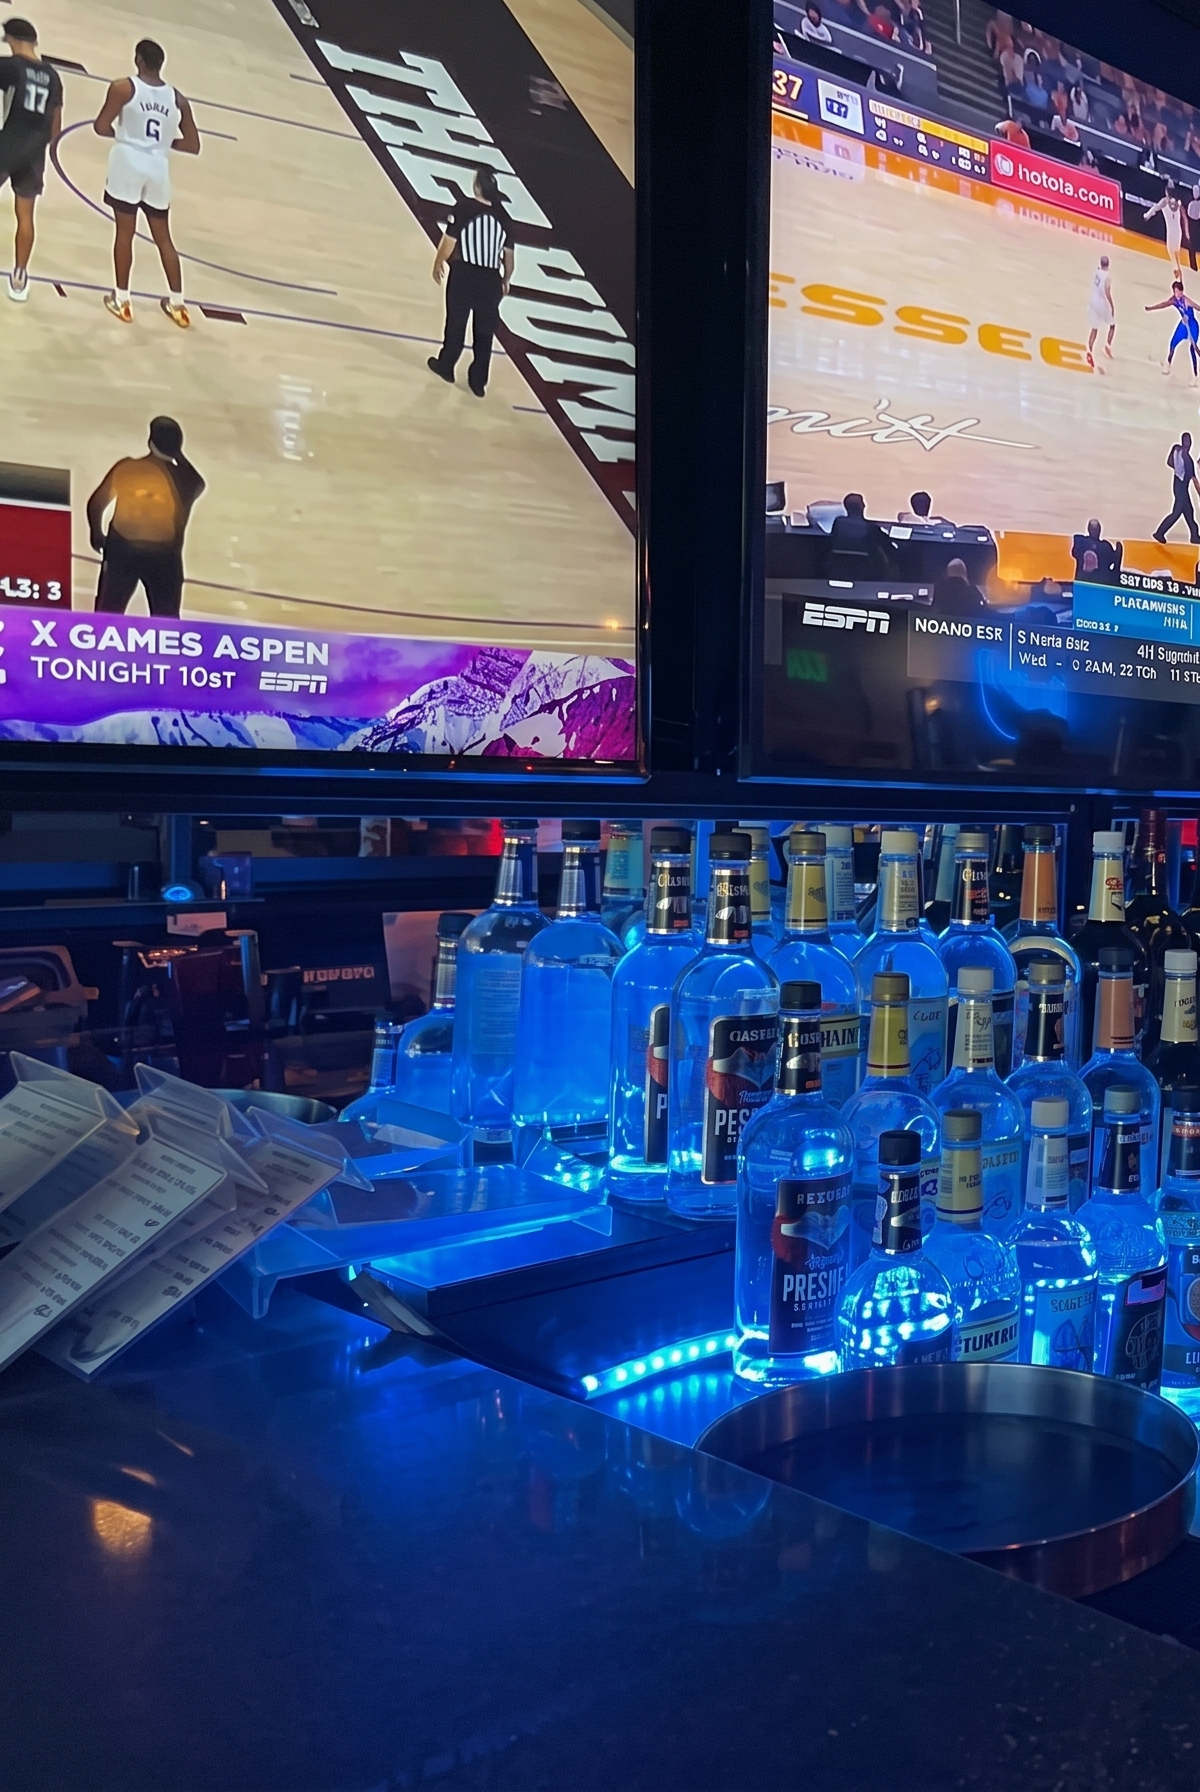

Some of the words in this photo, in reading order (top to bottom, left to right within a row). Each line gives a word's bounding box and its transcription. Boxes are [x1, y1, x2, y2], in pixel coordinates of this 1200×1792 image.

[315, 38, 552, 232] THE
[47, 581, 62, 601] 3
[802, 602, 890, 634] ESPN
[31, 620, 57, 647] X
[69, 625, 203, 657] GAMES
[213, 635, 329, 666] ASPEN
[30, 656, 170, 685] TONIGHT
[259, 671, 327, 694] ESPN
